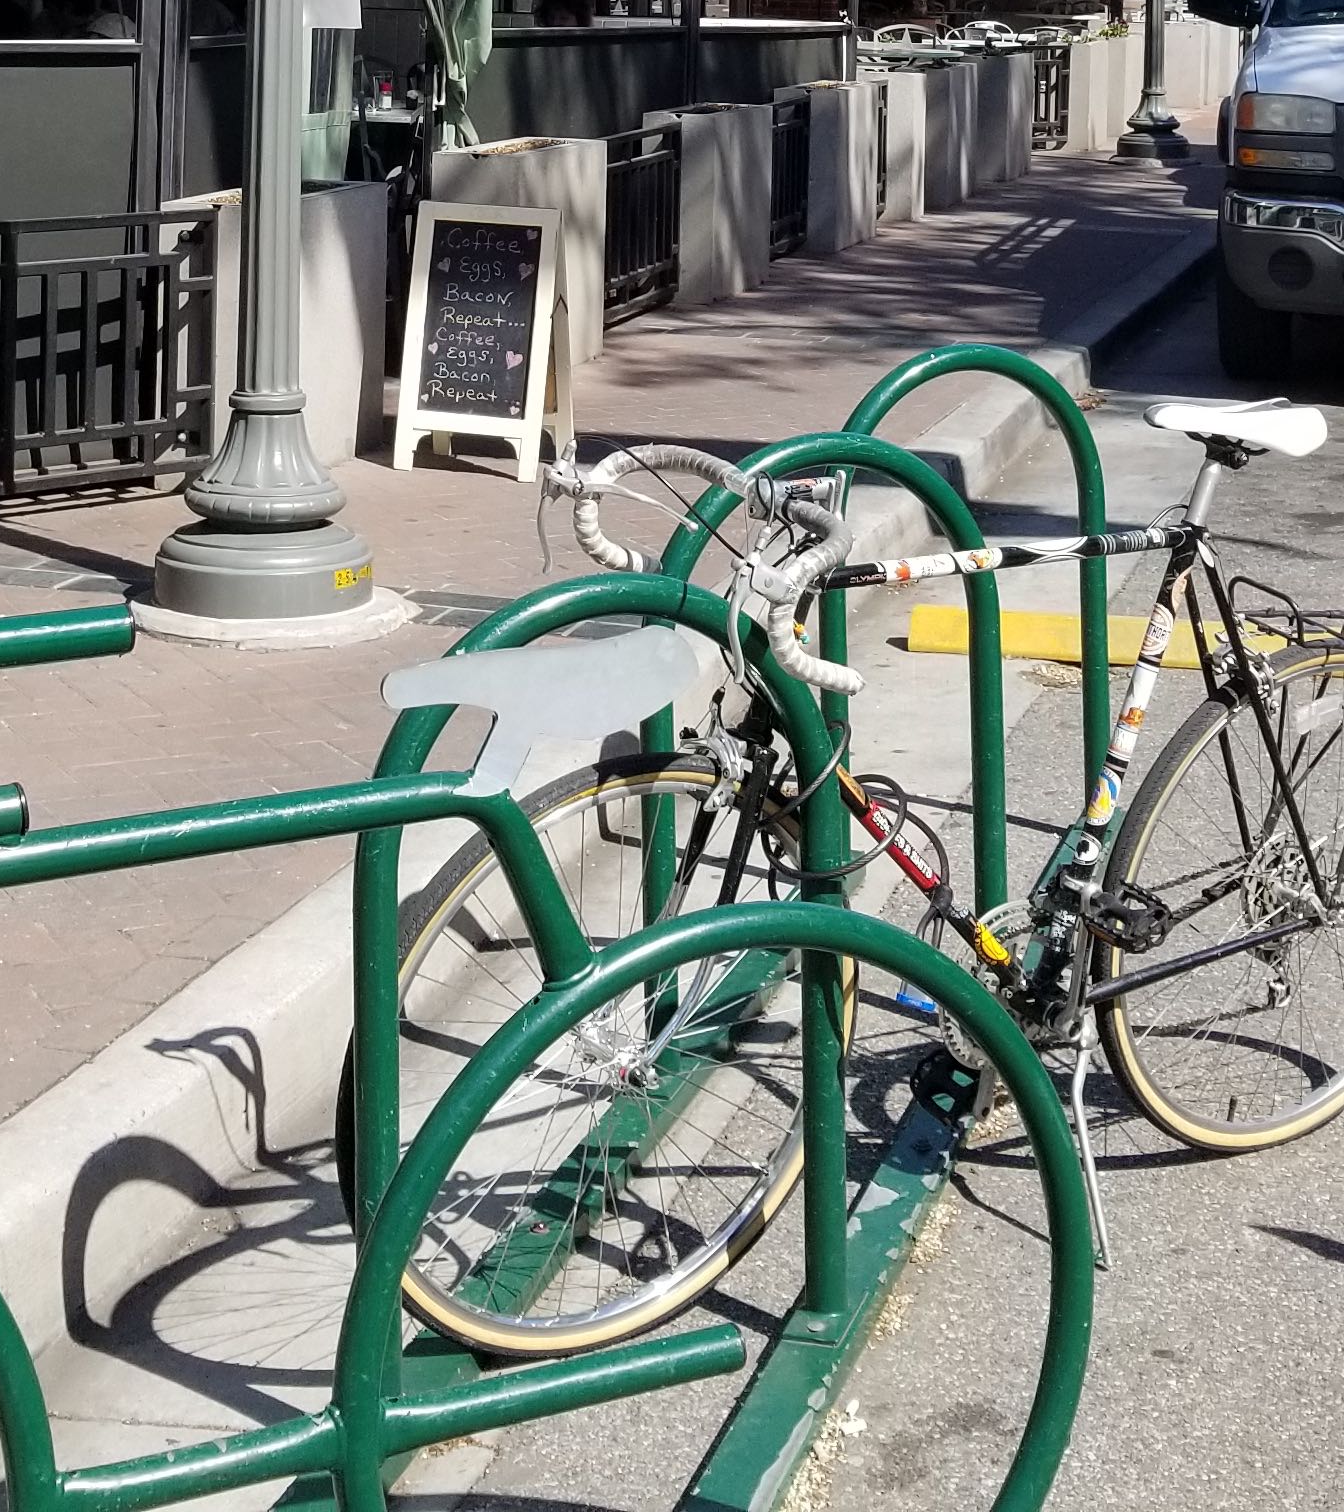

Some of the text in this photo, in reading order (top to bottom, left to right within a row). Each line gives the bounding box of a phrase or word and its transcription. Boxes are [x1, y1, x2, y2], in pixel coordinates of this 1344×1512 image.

[459, 256, 506, 282] Eggs,
[436, 327, 500, 350] Coffee,
[446, 346, 494, 367] Eggs,
